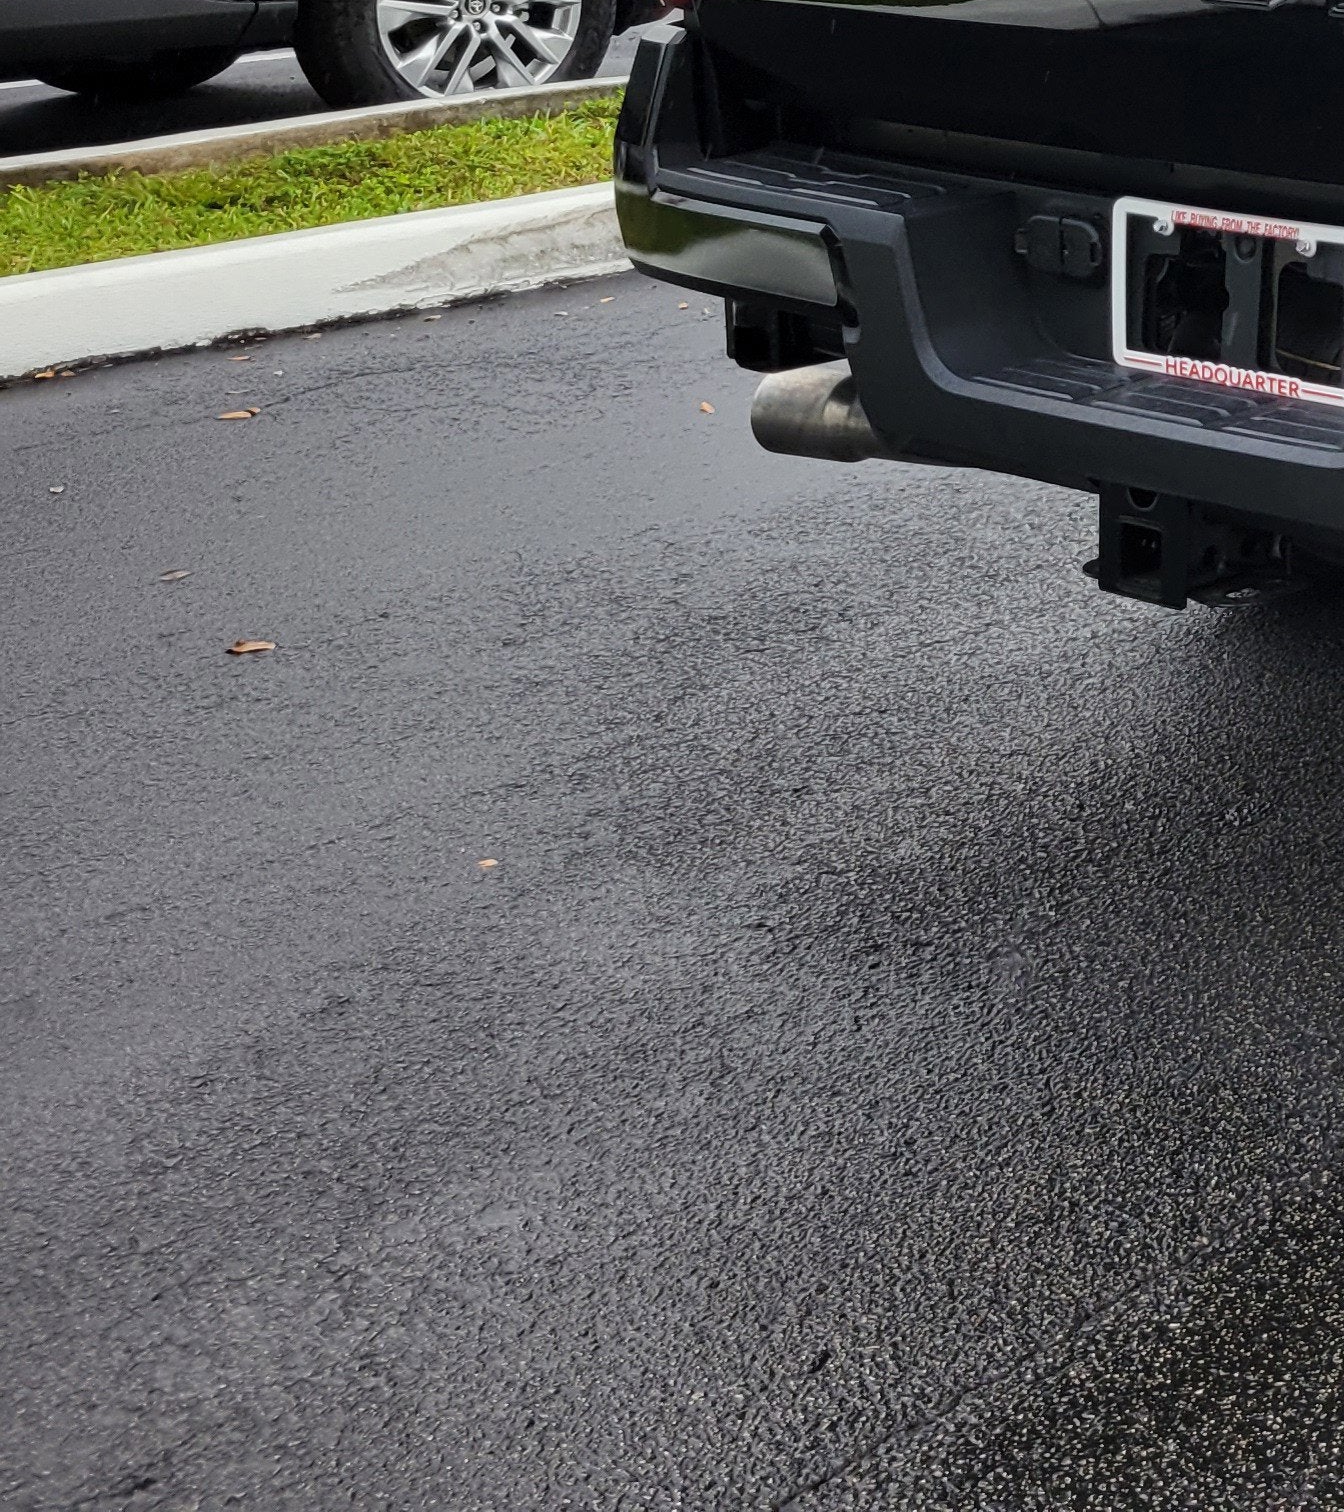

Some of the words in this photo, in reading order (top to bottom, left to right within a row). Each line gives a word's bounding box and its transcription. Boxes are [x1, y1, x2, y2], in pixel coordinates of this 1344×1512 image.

[1171, 210, 1187, 223] LIKE
[1190, 213, 1217, 228] BUYING
[1222, 217, 1242, 232] FROM
[1247, 221, 1260, 234] THE
[1165, 357, 1300, 397] HEADQUARTER
